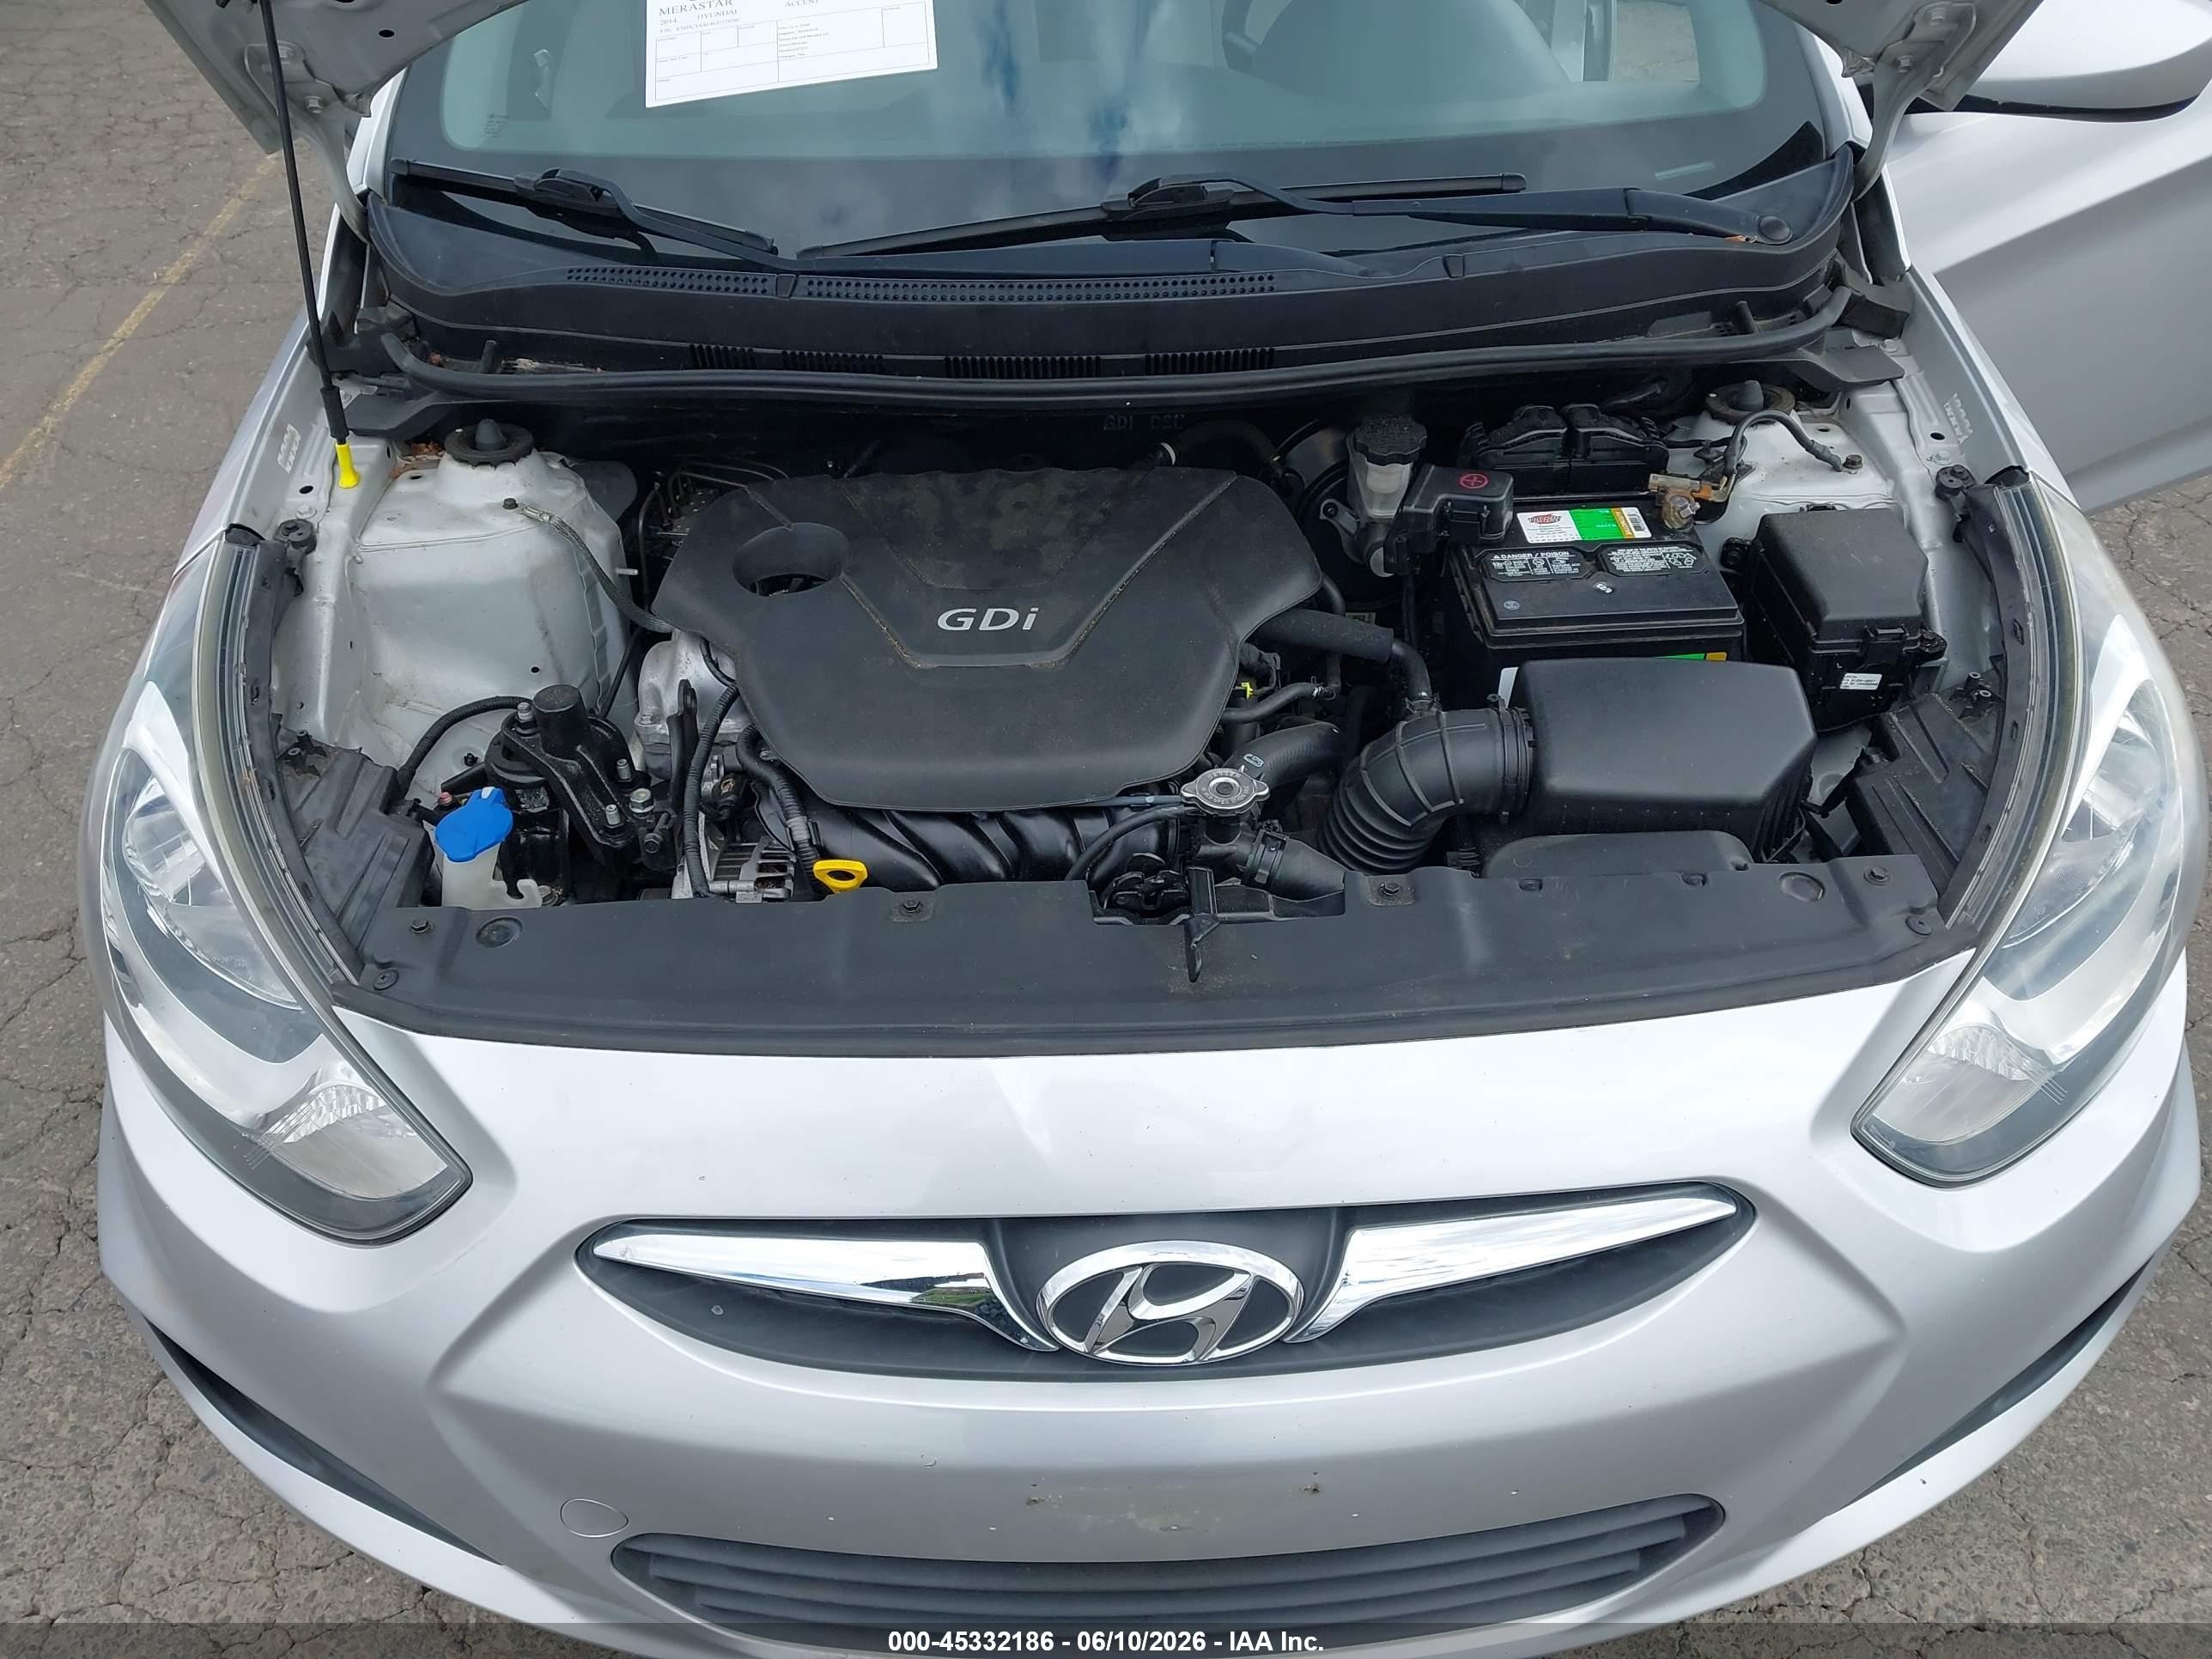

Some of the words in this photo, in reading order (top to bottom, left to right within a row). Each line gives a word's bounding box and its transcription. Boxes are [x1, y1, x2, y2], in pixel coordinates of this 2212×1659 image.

[659, 0, 733, 16] MERASTAR
[697, 9, 738, 21] HYUNDAI
[937, 607, 1039, 631] GDi
